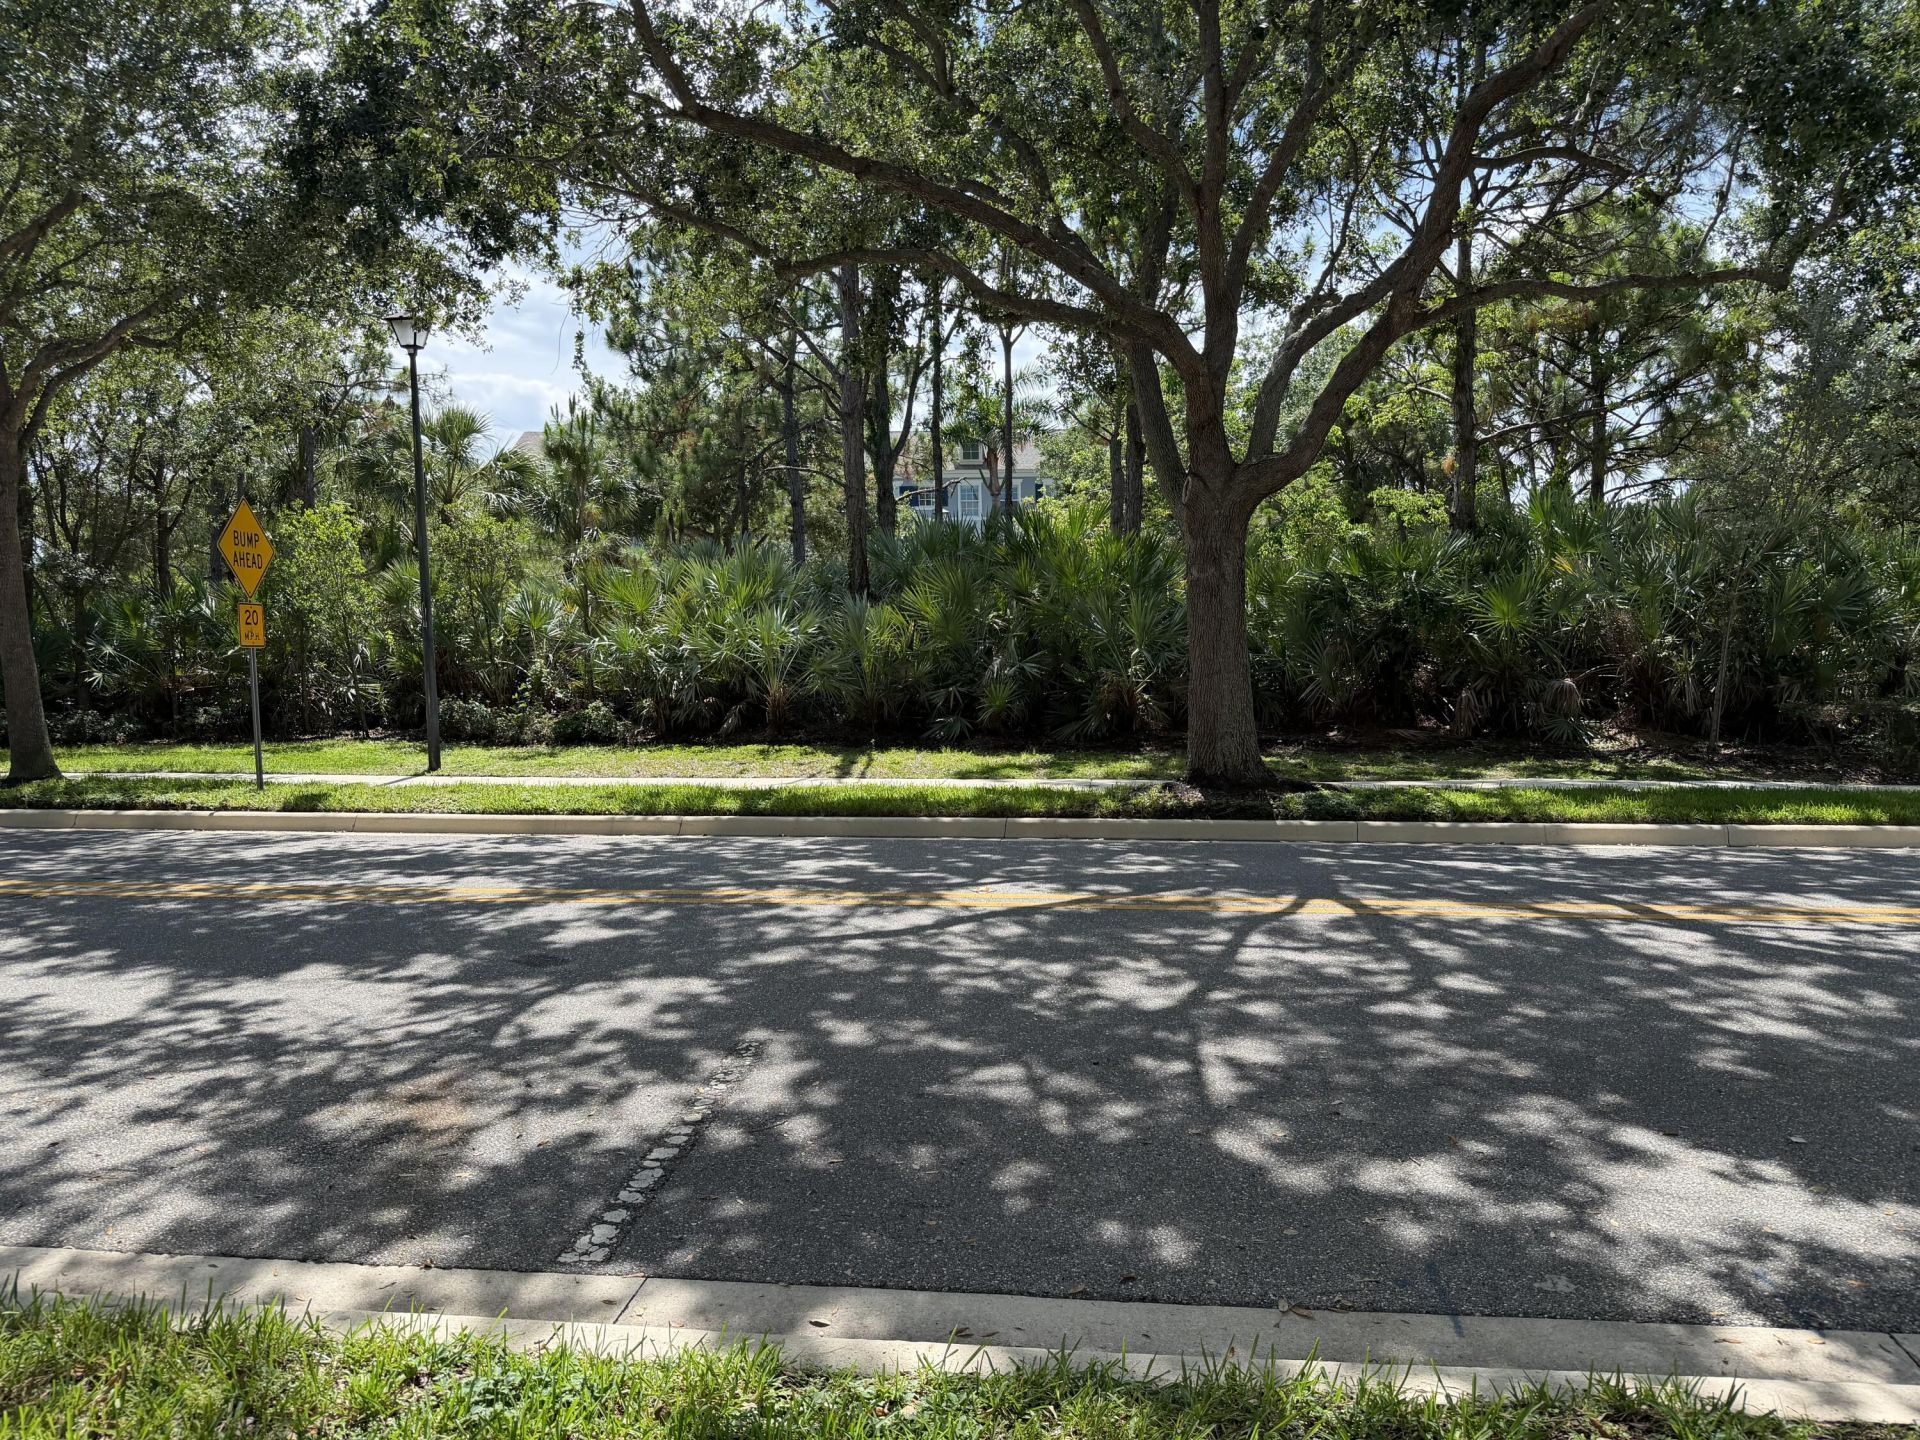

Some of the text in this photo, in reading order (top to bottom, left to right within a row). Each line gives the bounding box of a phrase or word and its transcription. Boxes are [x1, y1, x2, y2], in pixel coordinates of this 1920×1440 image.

[233, 530, 260, 549] BUMP
[233, 553, 263, 570] AHEAD
[244, 609, 259, 626] 20
